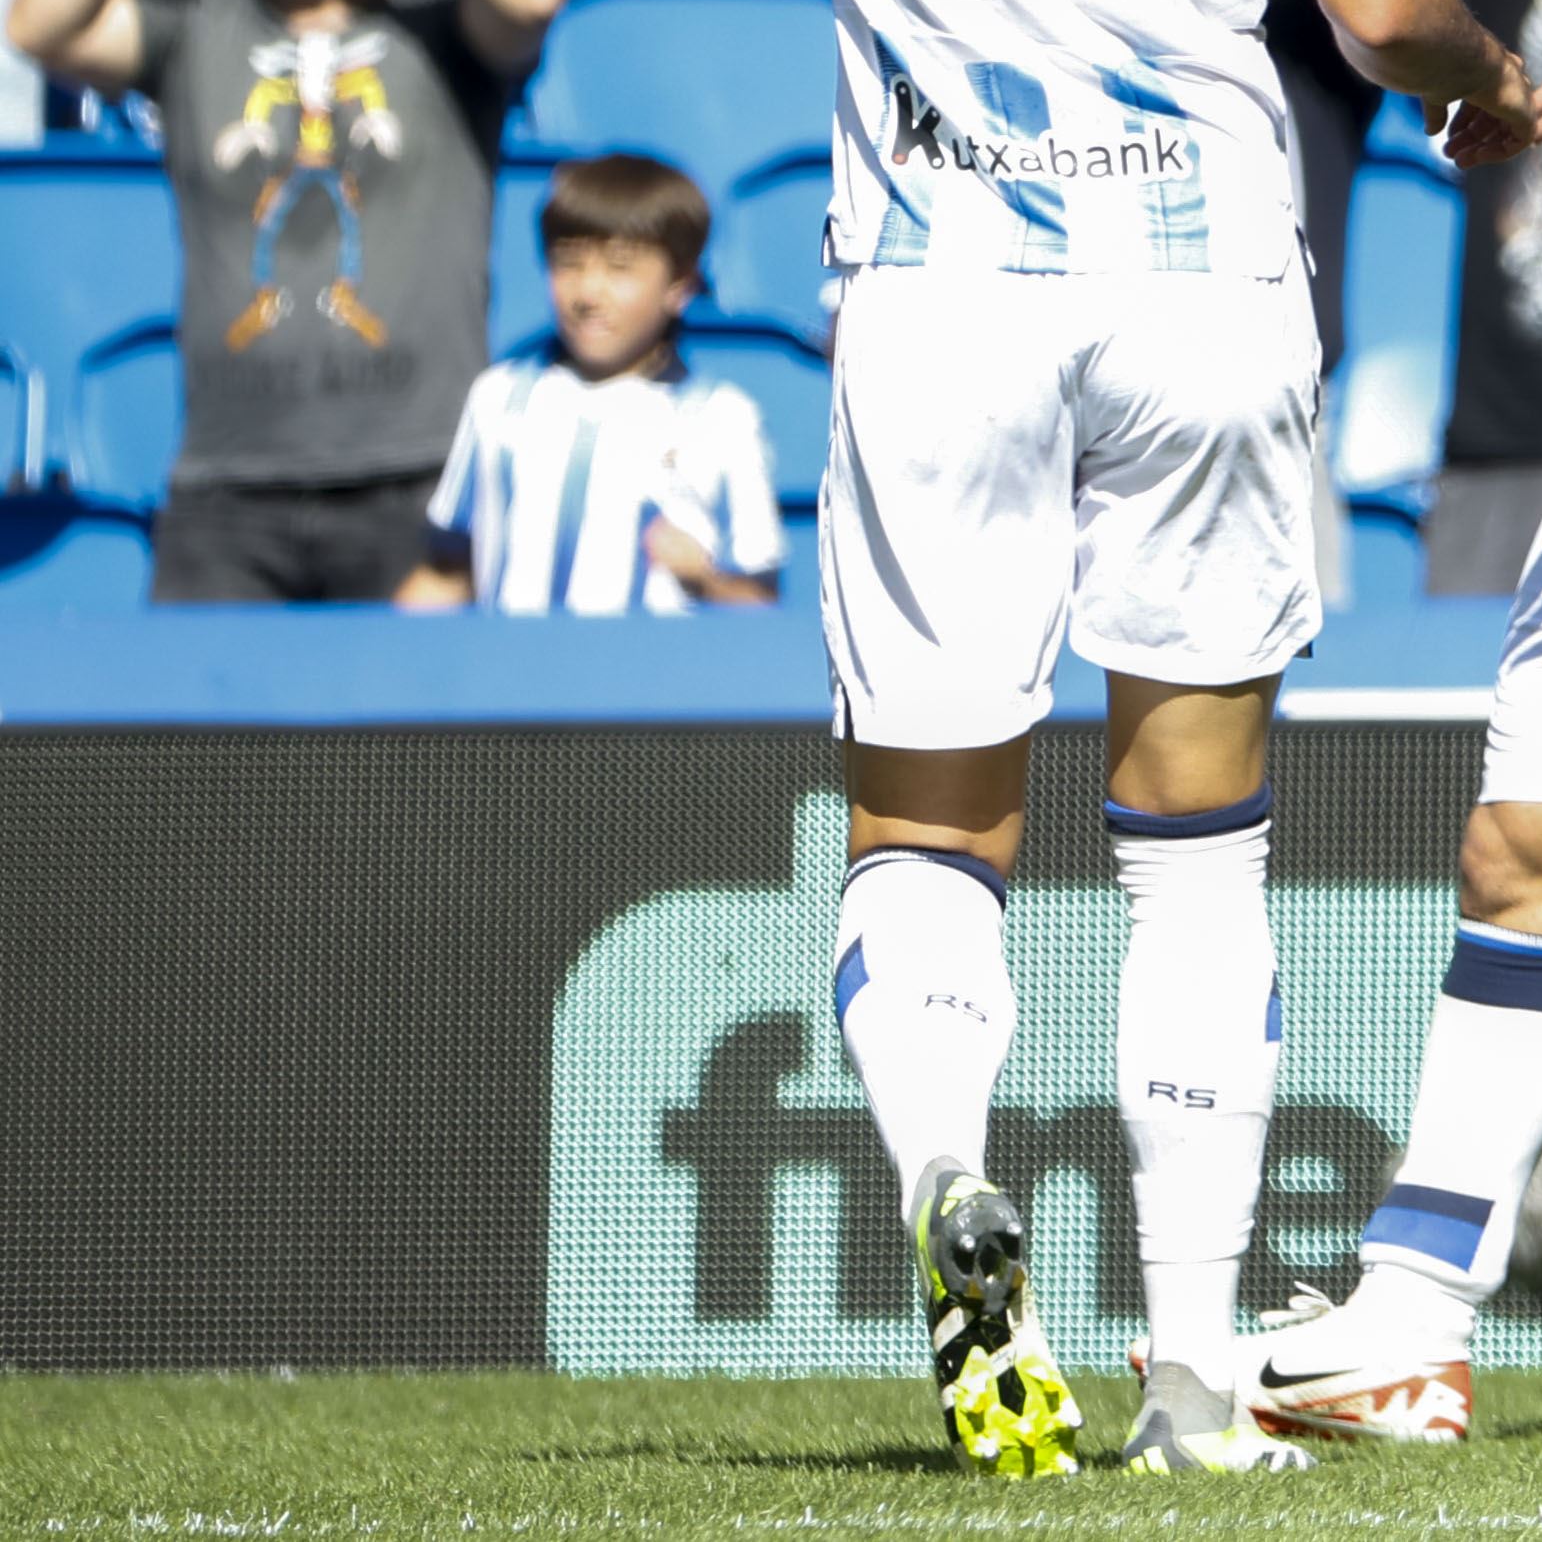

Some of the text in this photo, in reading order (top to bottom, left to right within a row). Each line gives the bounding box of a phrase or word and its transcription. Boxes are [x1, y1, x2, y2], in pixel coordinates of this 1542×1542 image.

[891, 80, 1185, 178] Kutxabank
[924, 993, 988, 1024] RS
[1148, 1079, 1217, 1110] RS
